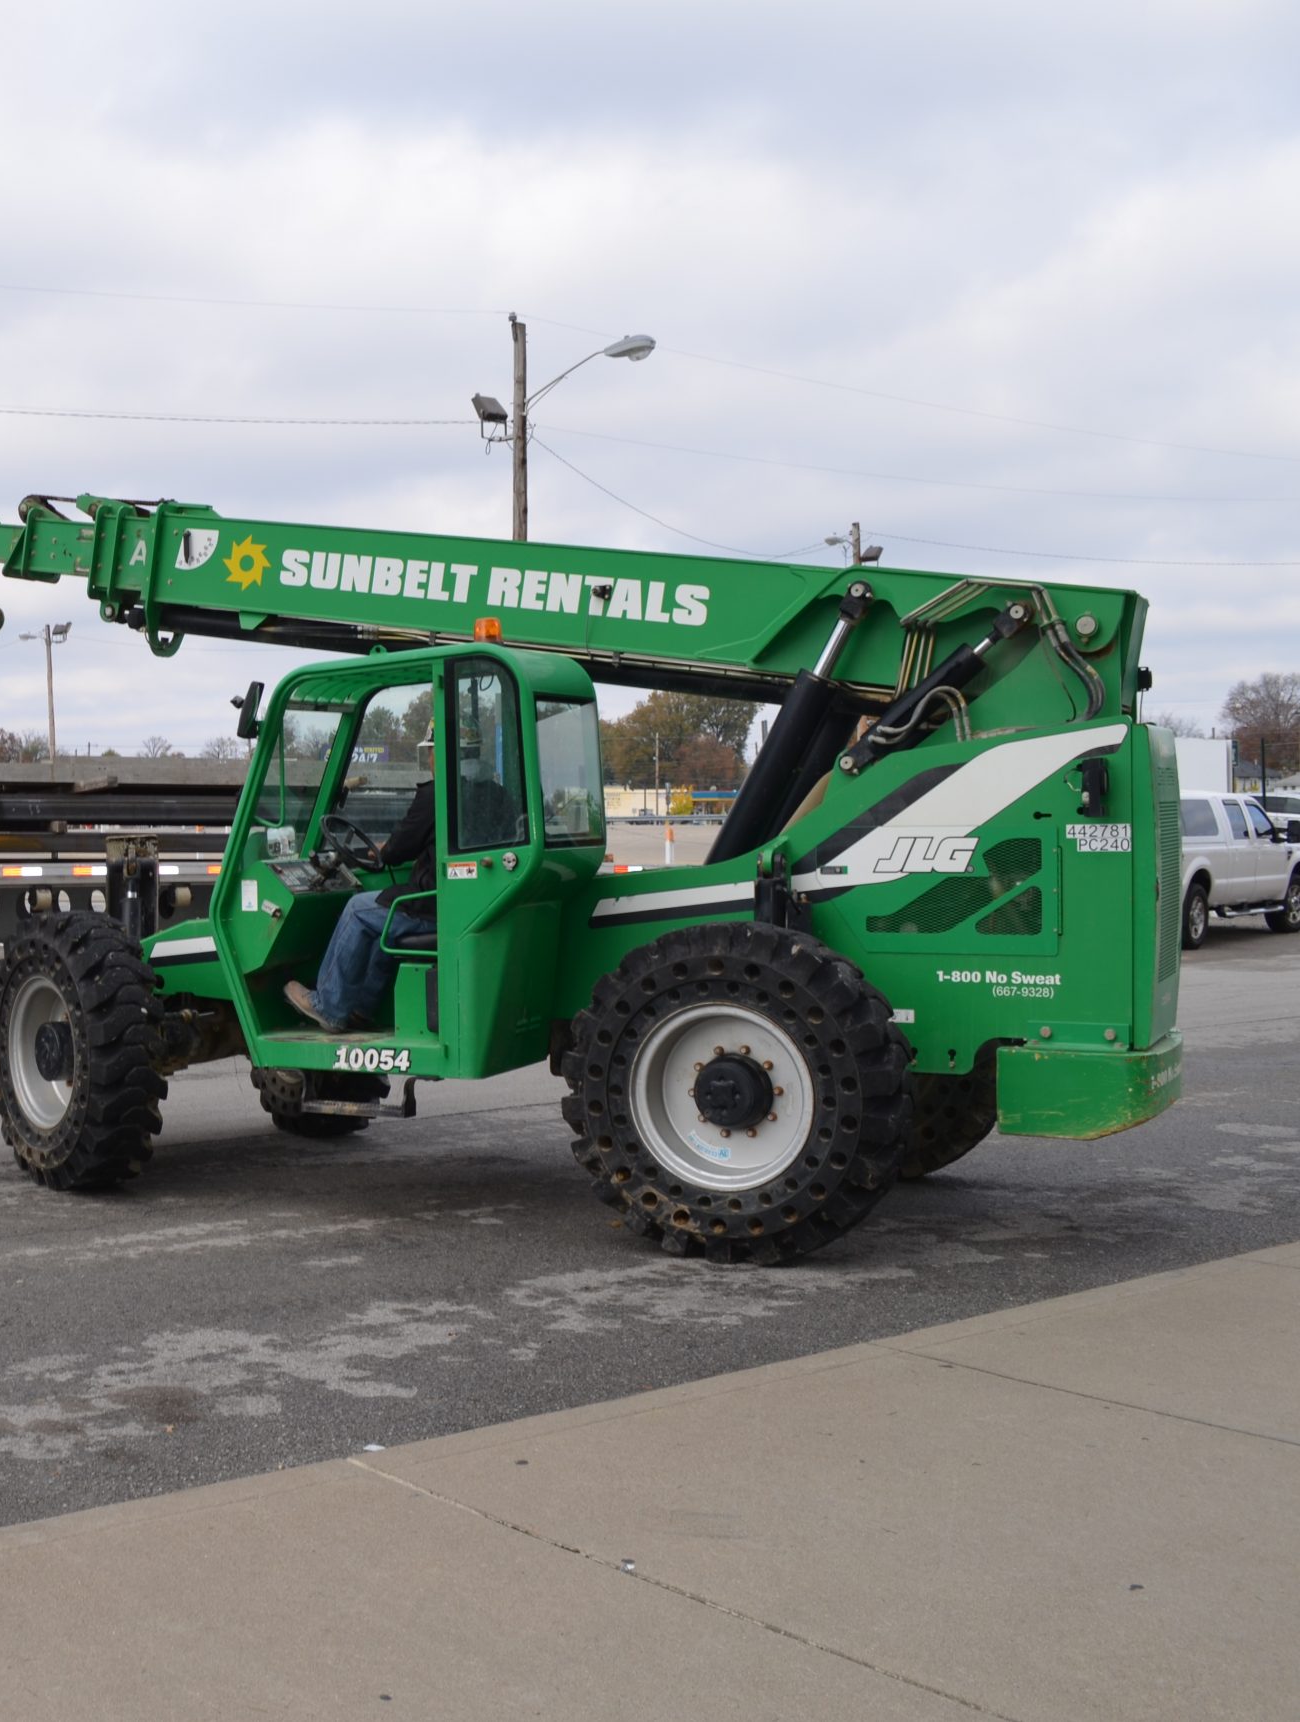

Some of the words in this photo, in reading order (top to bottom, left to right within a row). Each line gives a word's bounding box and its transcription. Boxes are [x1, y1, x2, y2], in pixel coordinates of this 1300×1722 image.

[279, 548, 478, 603] SUNBELT
[486, 566, 711, 627] RENTALS
[1067, 824, 1128, 838] 442781
[1078, 838, 1131, 851] PC240
[872, 836, 980, 873] JLG
[936, 970, 981, 983] 1-800
[985, 971, 1007, 984] No
[1011, 972, 1061, 986] Sweat
[992, 985, 1054, 999] (667-9328)
[333, 1045, 411, 1072] 10054
